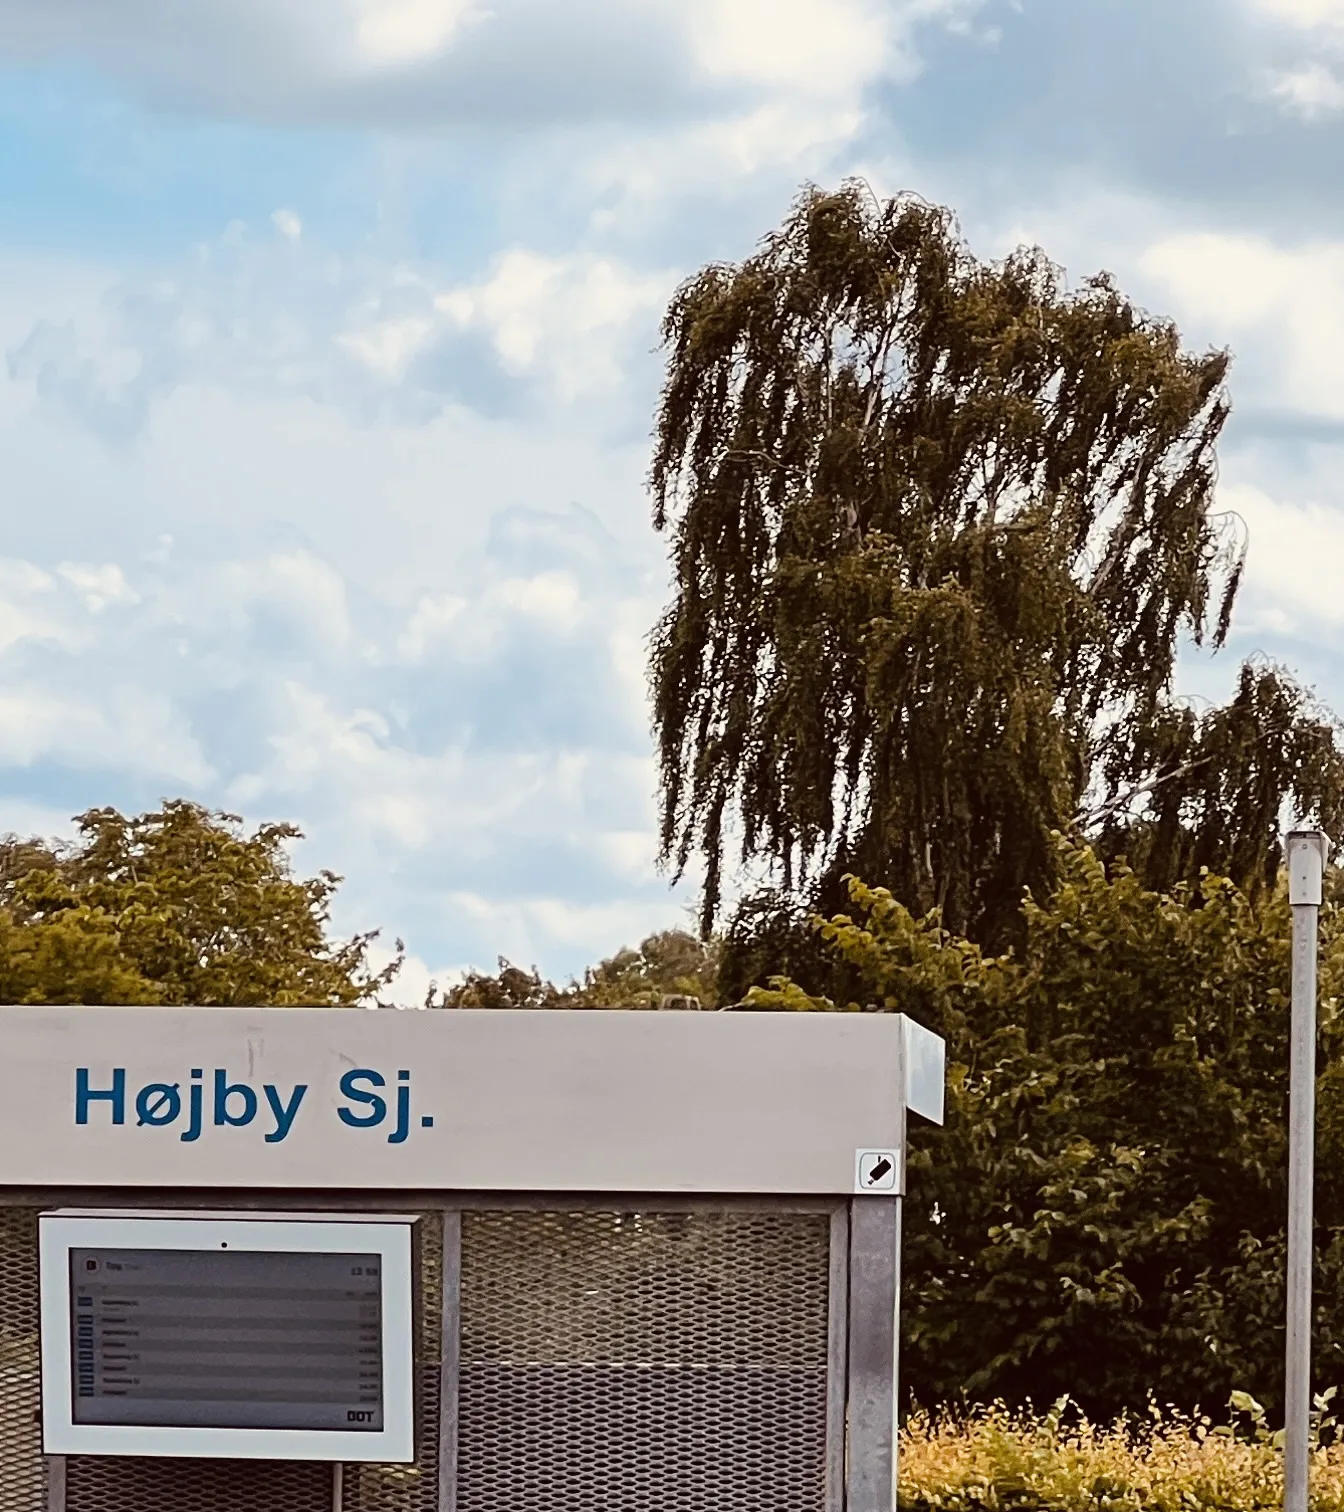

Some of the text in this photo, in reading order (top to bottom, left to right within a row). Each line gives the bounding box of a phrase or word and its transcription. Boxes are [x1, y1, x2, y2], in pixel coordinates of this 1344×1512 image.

[75, 1068, 435, 1143] Højby Sj.
[347, 1411, 374, 1423] DOT
